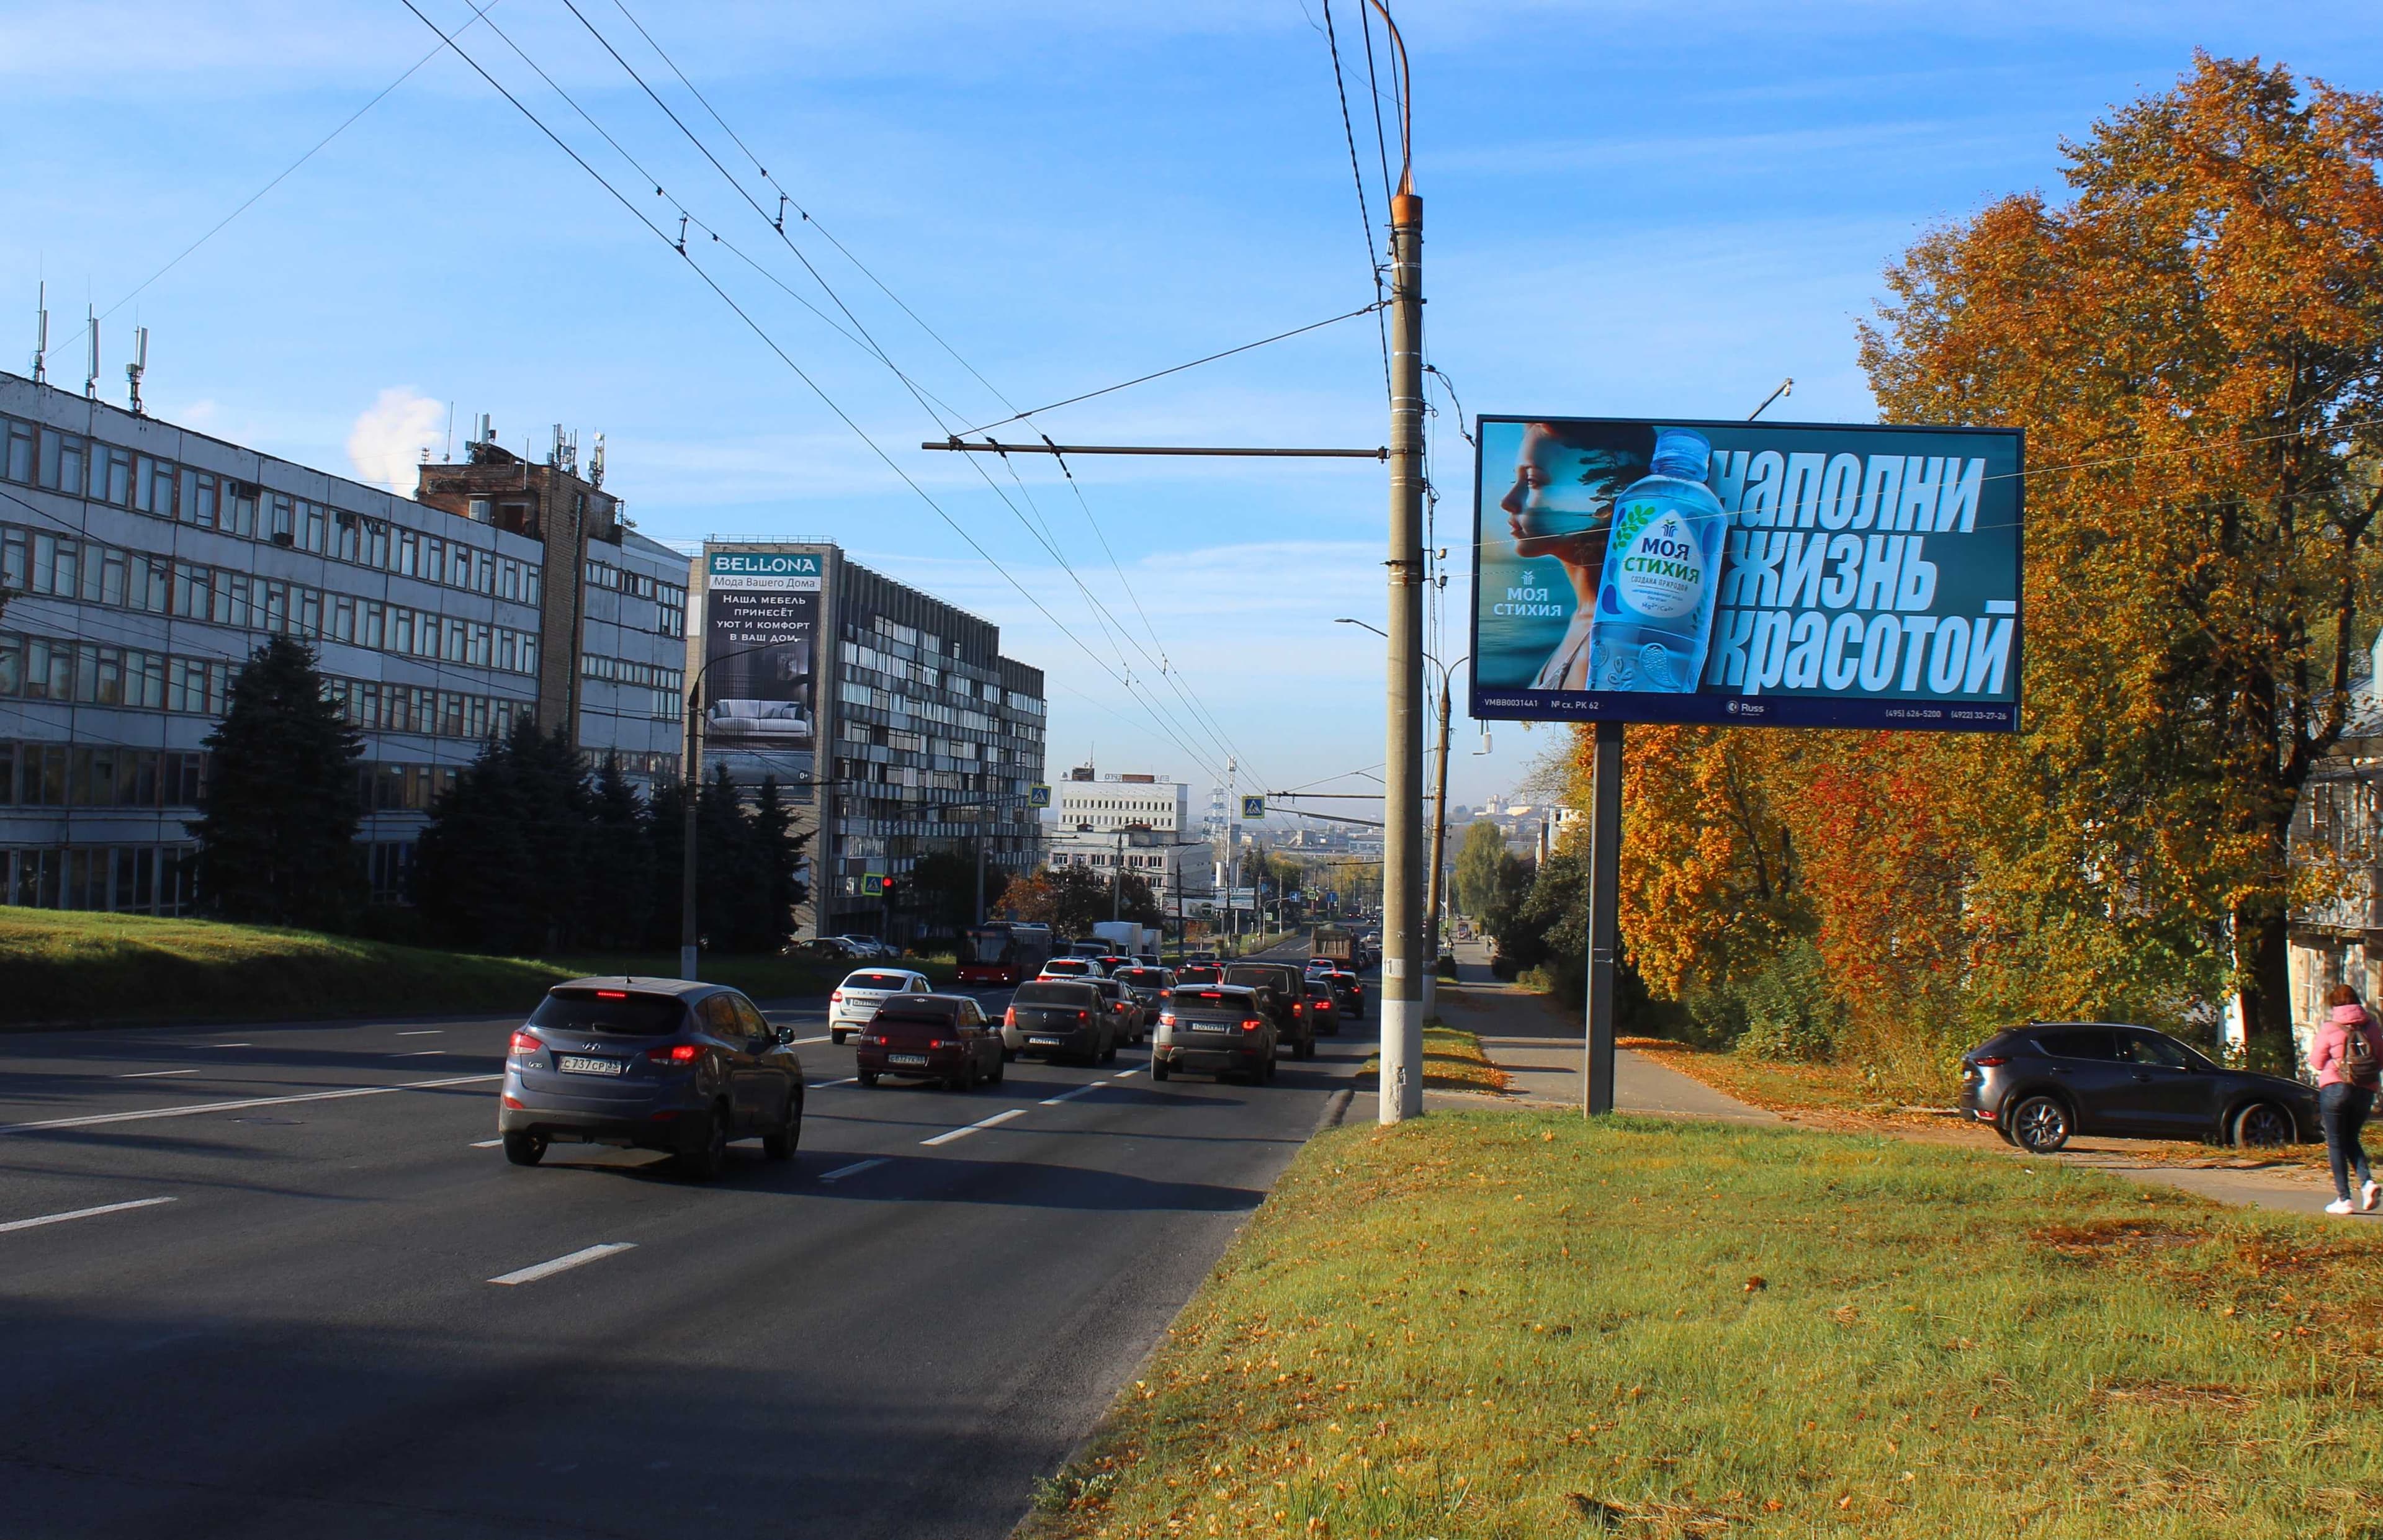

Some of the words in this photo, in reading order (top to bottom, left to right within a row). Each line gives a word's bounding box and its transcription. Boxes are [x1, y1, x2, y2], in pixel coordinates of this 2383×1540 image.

[1707, 450, 1986, 534] наполни
[1641, 537, 1690, 561] МОЯ
[714, 557, 817, 573] BELLONA
[1623, 557, 1700, 584] СТИХИЯ
[1720, 530, 1937, 612] жизнь
[714, 576, 743, 587] Мода
[747, 577, 784, 588] Вашего
[786, 578, 815, 589] Дома
[1630, 575, 1658, 584] СОЗДАНА
[1507, 587, 1548, 602] МОЯ
[734, 607, 794, 617] ПРИНЕСЁТ
[1493, 602, 1561, 616] СТИХИЯ
[716, 620, 741, 629] УЮТ
[757, 621, 810, 630] КОМФОРТ
[730, 633, 737, 641] В
[741, 633, 766, 642] ВАШ
[770, 634, 796, 643] ДОМ
[1706, 599, 2016, 696] красотой
[1484, 698, 1538, 707] VMBB00314A1
[1589, 701, 1599, 710] 62
[1741, 703, 1764, 713] Russ
[1885, 709, 1905, 718] (495)
[1906, 710, 1942, 719] 626-5200
[1951, 710, 1973, 720] (4922)
[1974, 711, 2008, 720] 33-27-26
